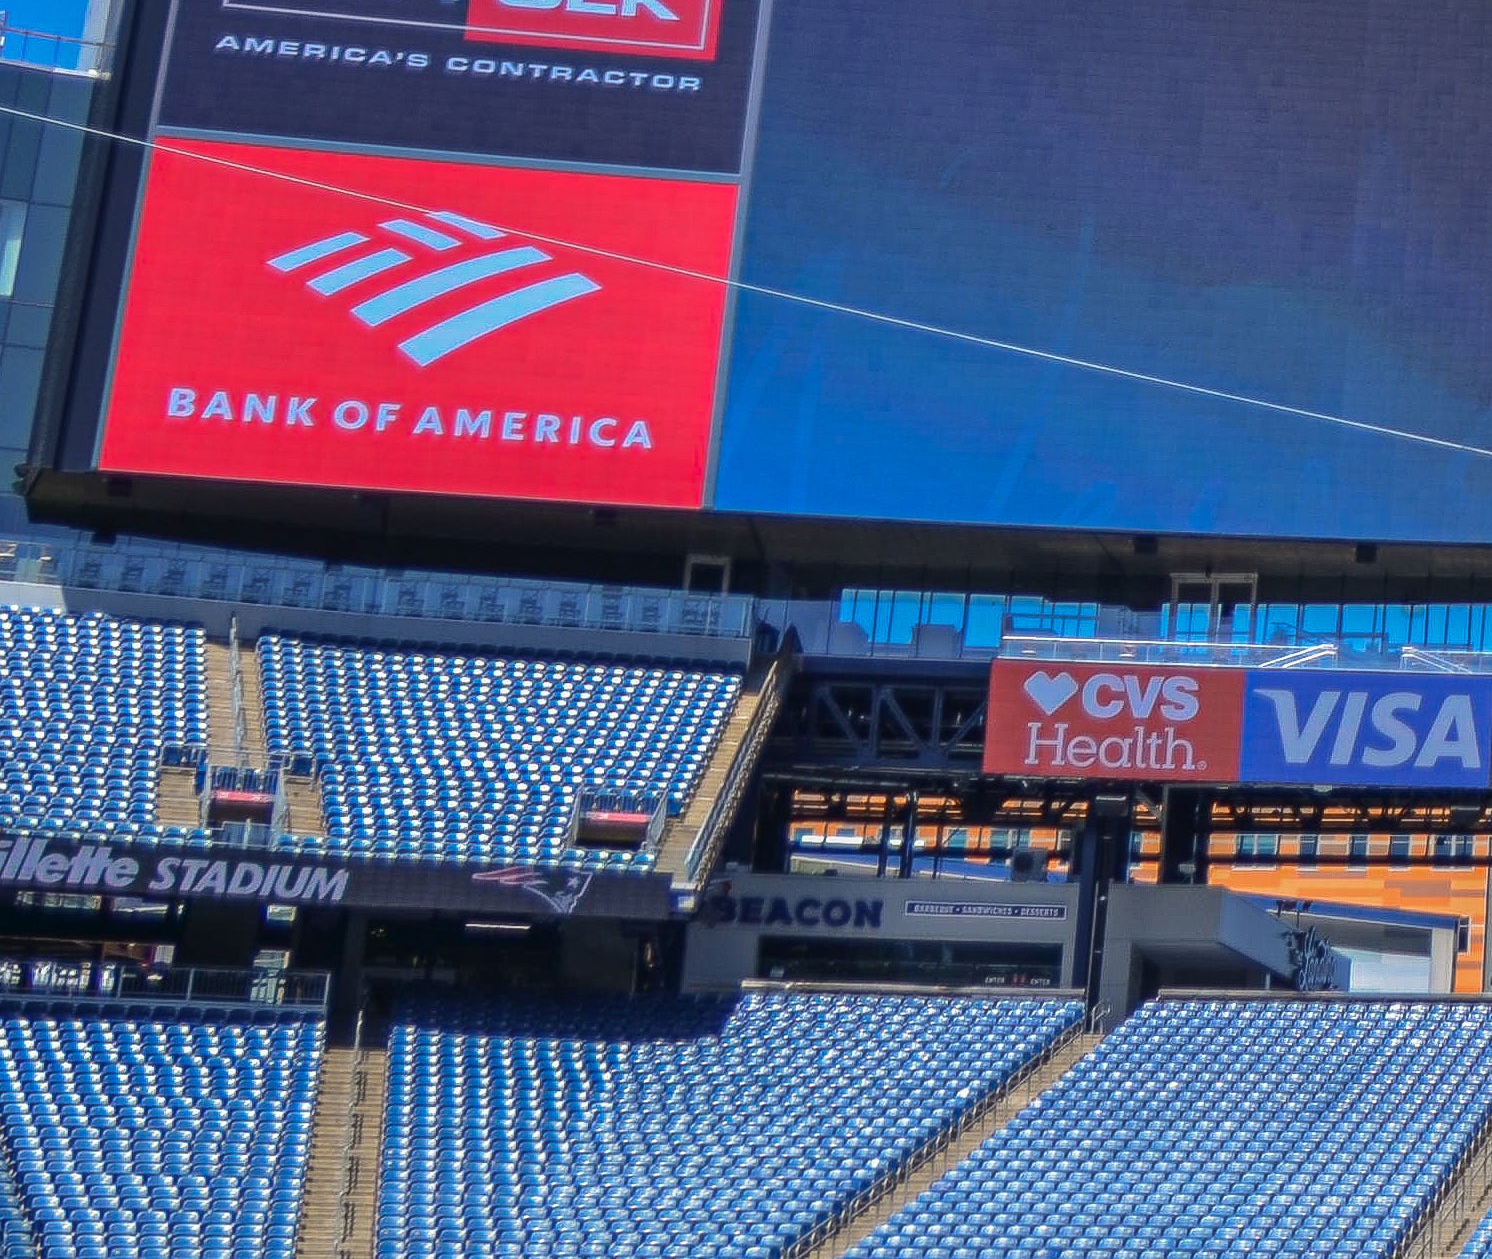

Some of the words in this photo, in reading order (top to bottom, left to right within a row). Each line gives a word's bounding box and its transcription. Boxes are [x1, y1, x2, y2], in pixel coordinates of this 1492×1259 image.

[213, 34, 430, 69] AMERICA'S
[445, 56, 702, 91] CONTRACTOR
[167, 387, 316, 427] BANK
[333, 400, 401, 431] OF
[413, 406, 653, 450] AMERICA
[1082, 673, 1200, 721] CVS
[1024, 722, 1196, 771] Health
[1253, 689, 1482, 768] VISA
[0, 836, 140, 888] llette
[148, 856, 349, 901] STADIUM
[709, 895, 884, 929] BEACON
